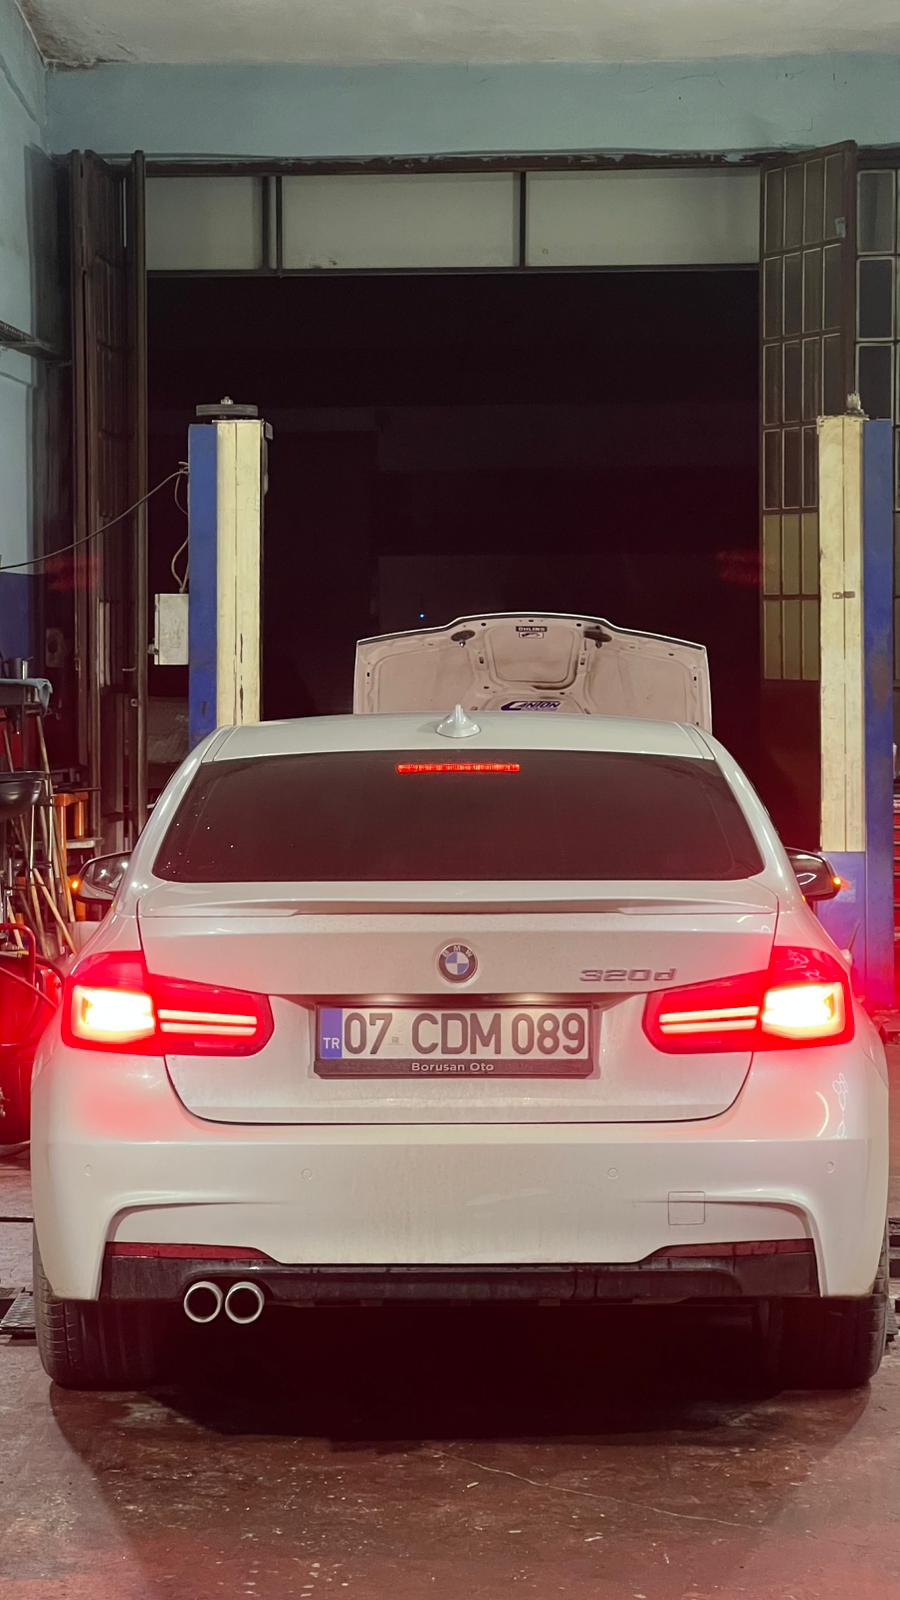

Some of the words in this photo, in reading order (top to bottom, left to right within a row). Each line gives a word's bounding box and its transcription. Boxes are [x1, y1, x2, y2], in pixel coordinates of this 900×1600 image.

[441, 945, 474, 958] BMW
[579, 968, 676, 981] 320d
[344, 1012, 393, 1054] 07
[411, 1012, 502, 1054] CDM
[511, 1012, 585, 1055] 089
[323, 1037, 340, 1049] TR
[411, 1062, 465, 1072] Borusan
[469, 1062, 494, 1072] Oto
